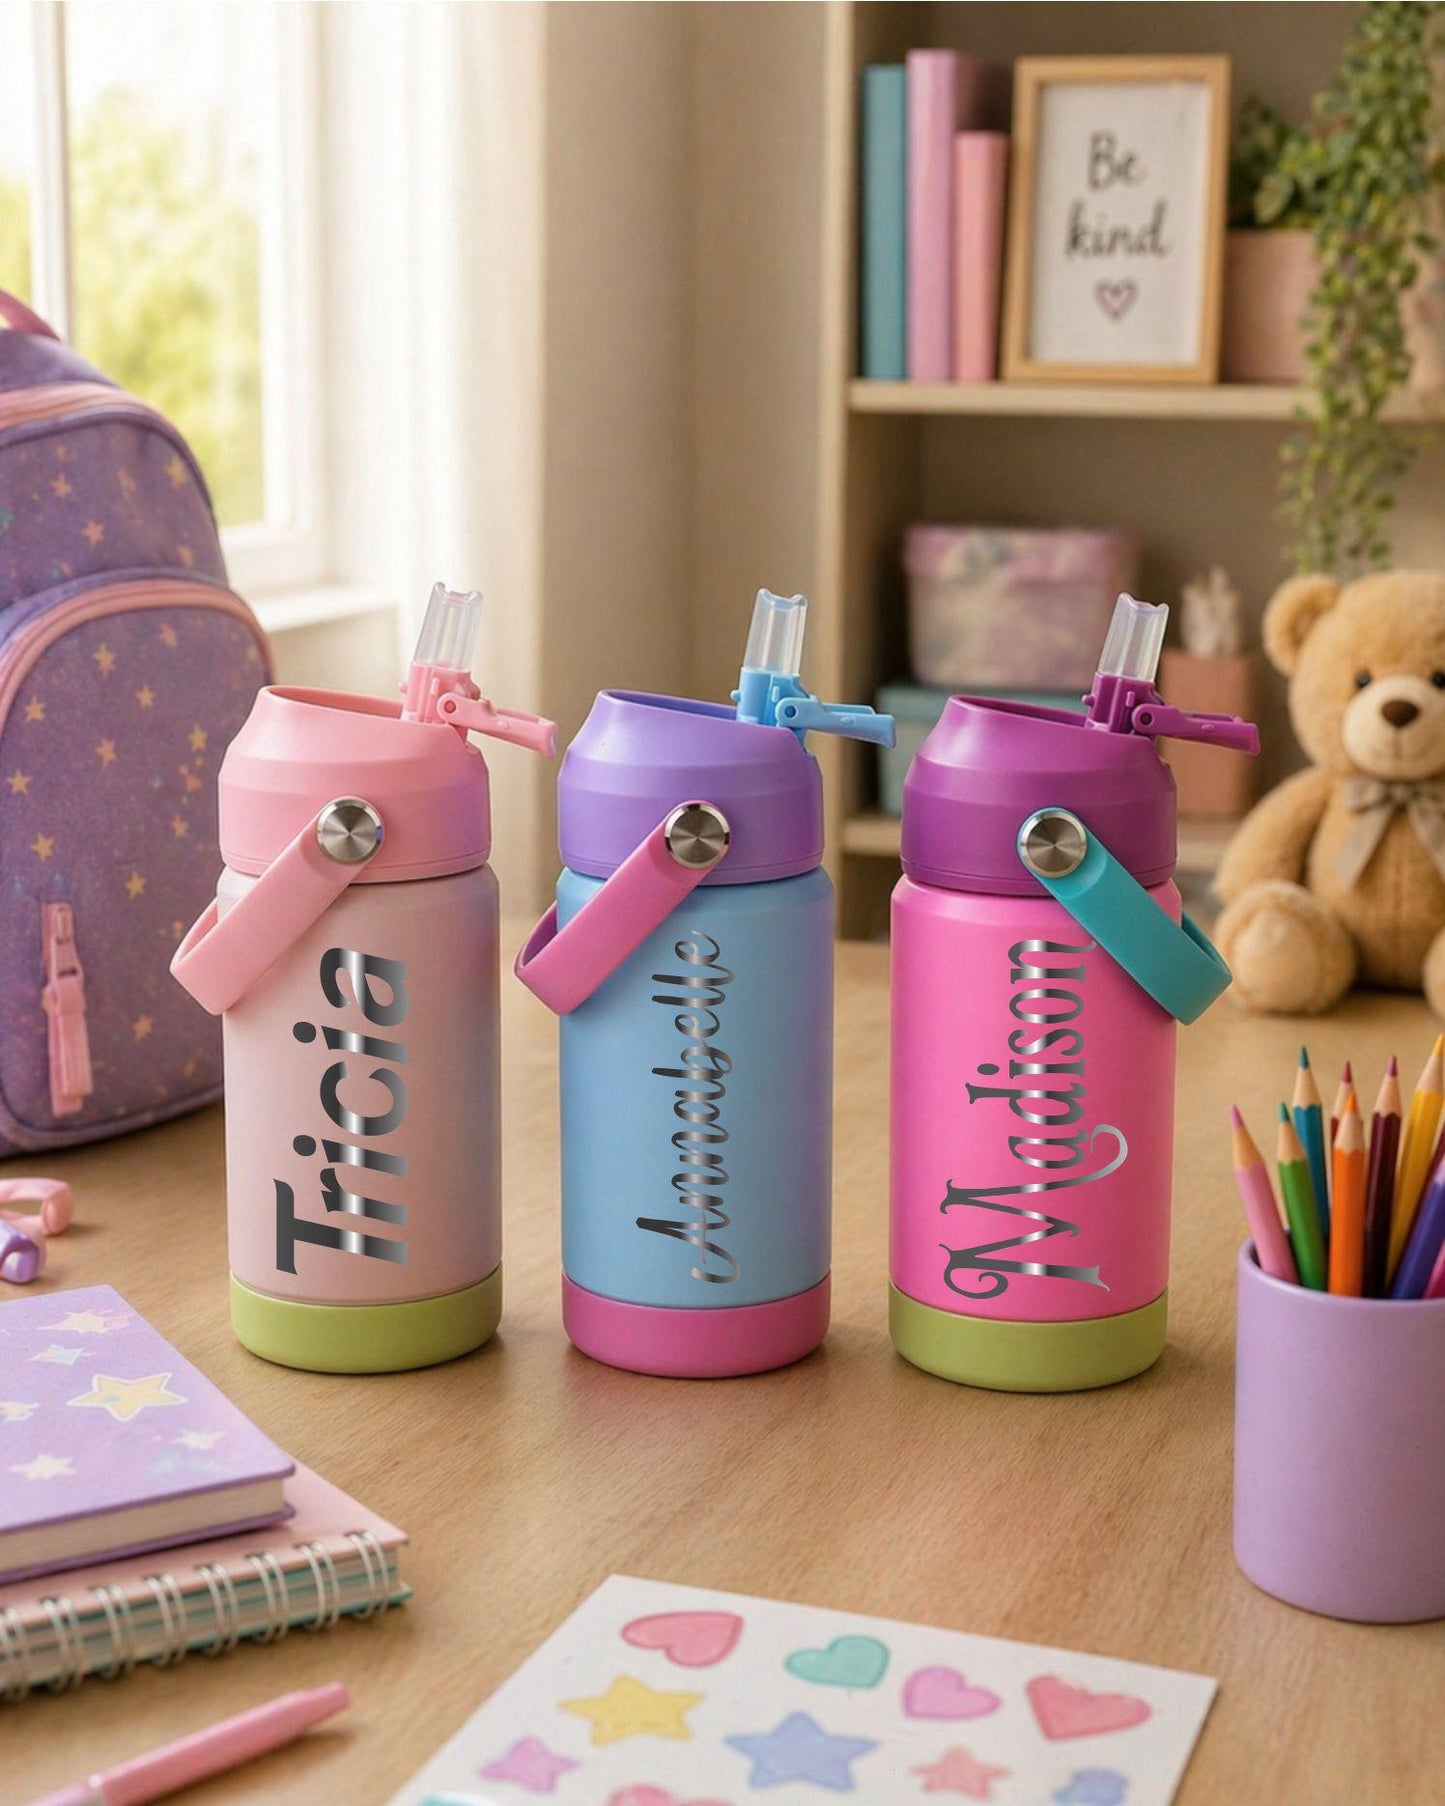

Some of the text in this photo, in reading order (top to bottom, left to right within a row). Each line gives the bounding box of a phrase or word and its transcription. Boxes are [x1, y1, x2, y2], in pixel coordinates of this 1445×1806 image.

[1065, 198, 1169, 258] kind
[1089, 131, 1144, 191] Be
[273, 947, 408, 1275] Tricia
[636, 929, 740, 1284] Annabelle
[938, 939, 1129, 1299] Madison
